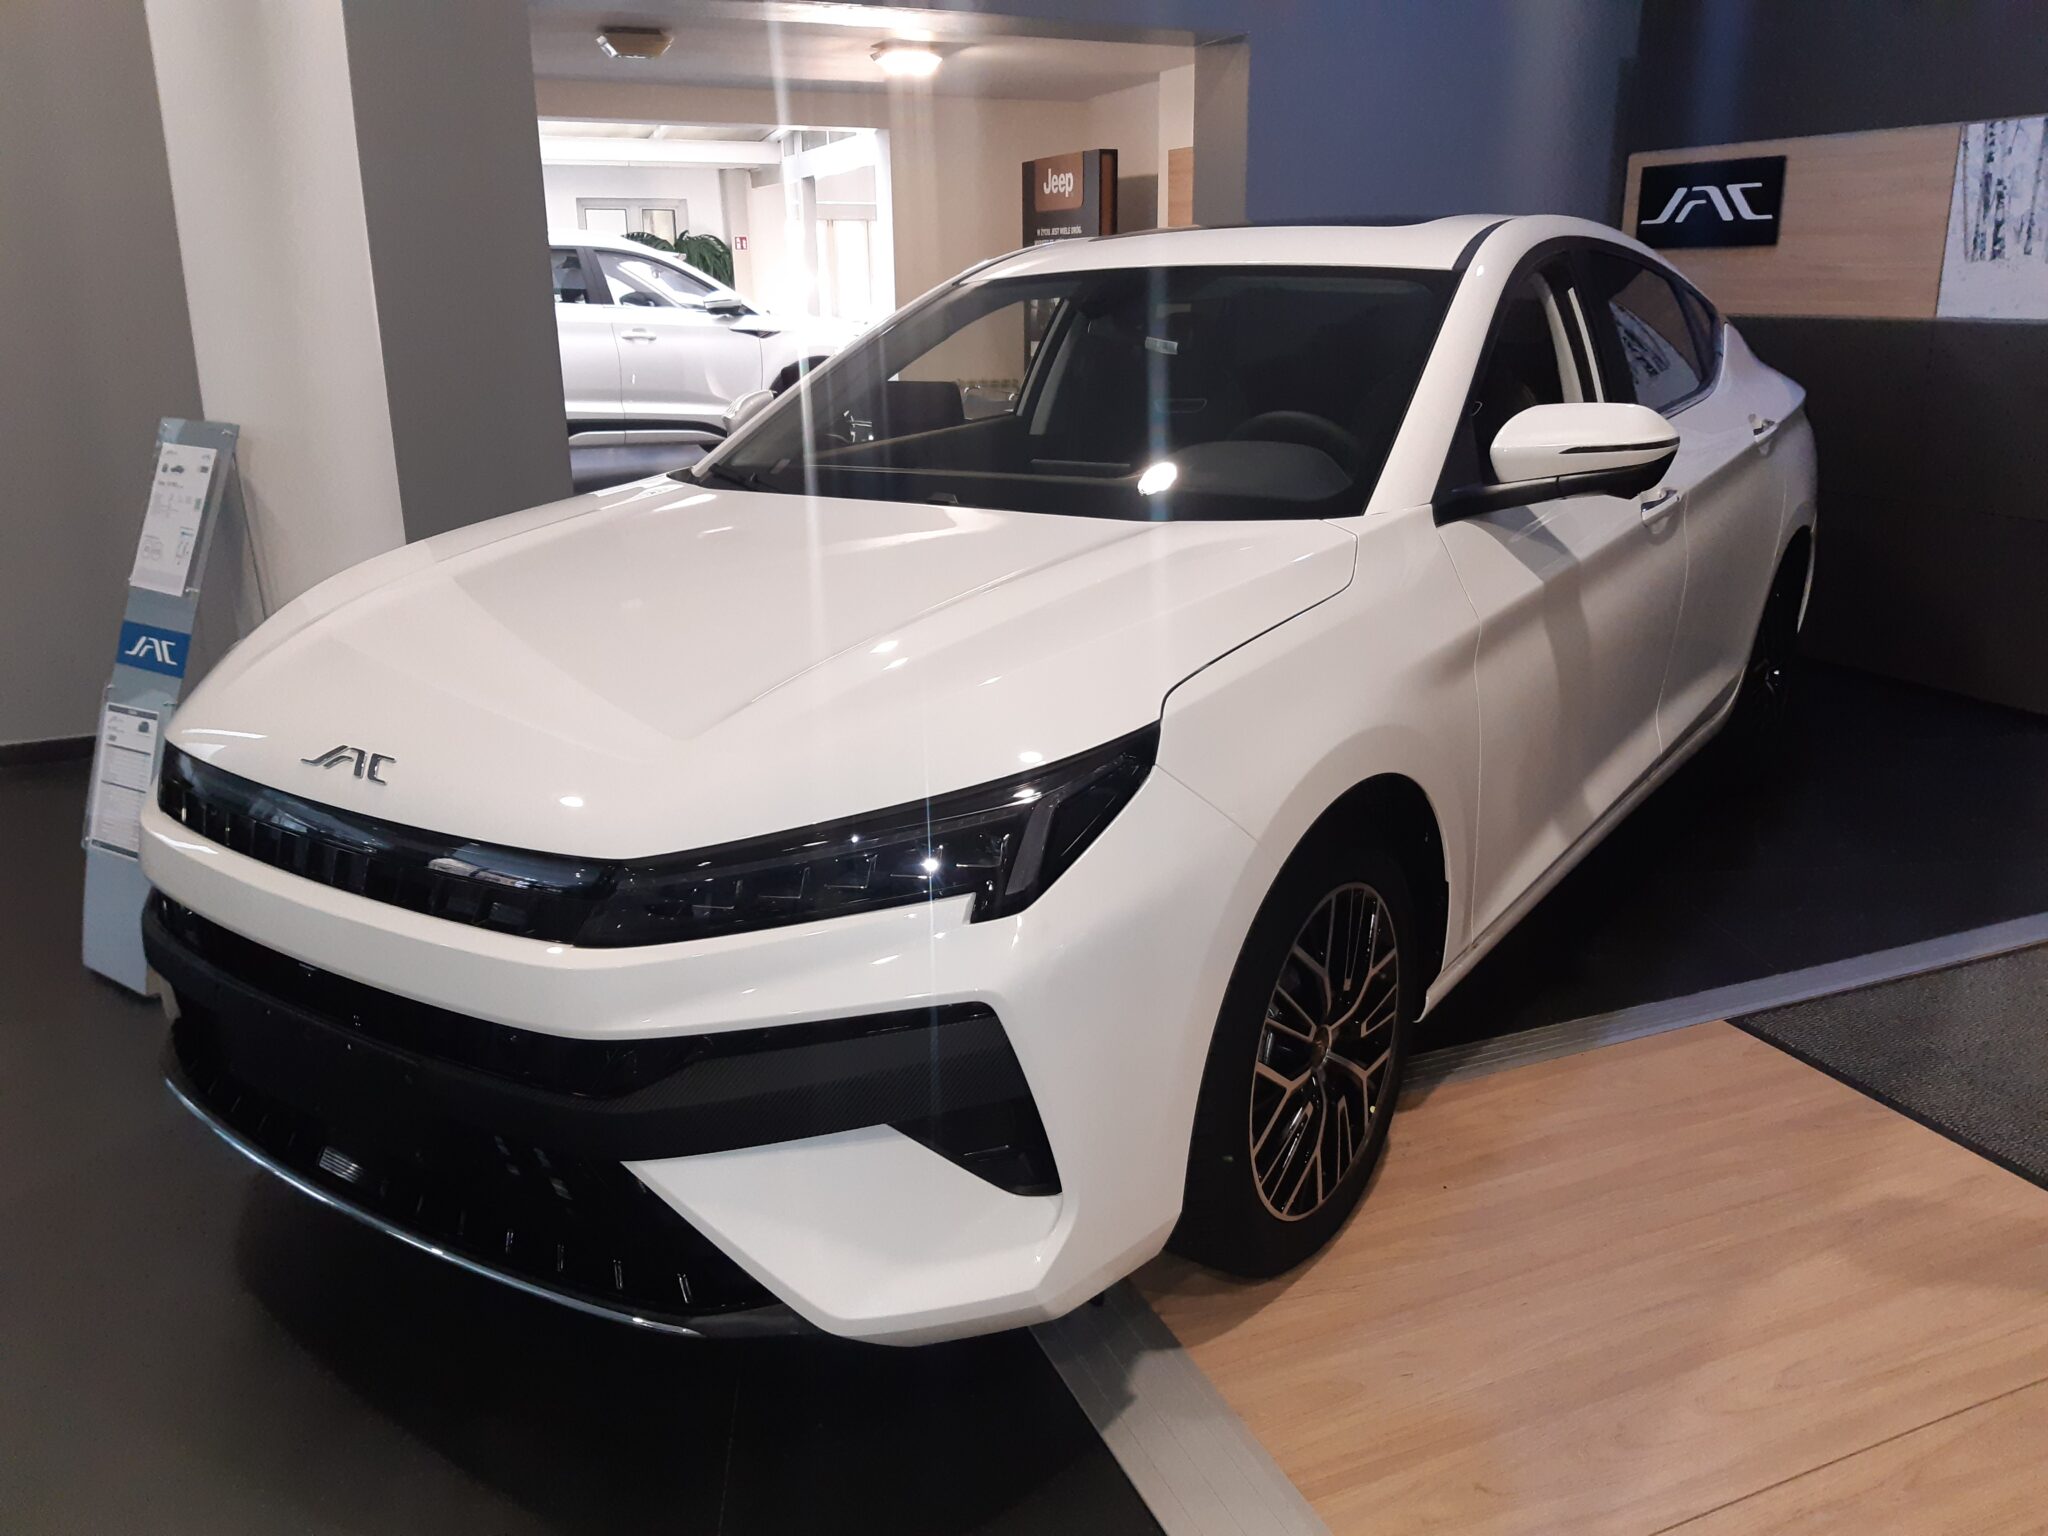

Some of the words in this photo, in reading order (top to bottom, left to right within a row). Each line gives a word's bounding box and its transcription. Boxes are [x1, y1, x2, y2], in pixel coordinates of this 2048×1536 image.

[1043, 168, 1074, 198] Jeep
[1640, 182, 1773, 225] JAC
[124, 636, 178, 666] JAC
[300, 745, 397, 786] JAC
